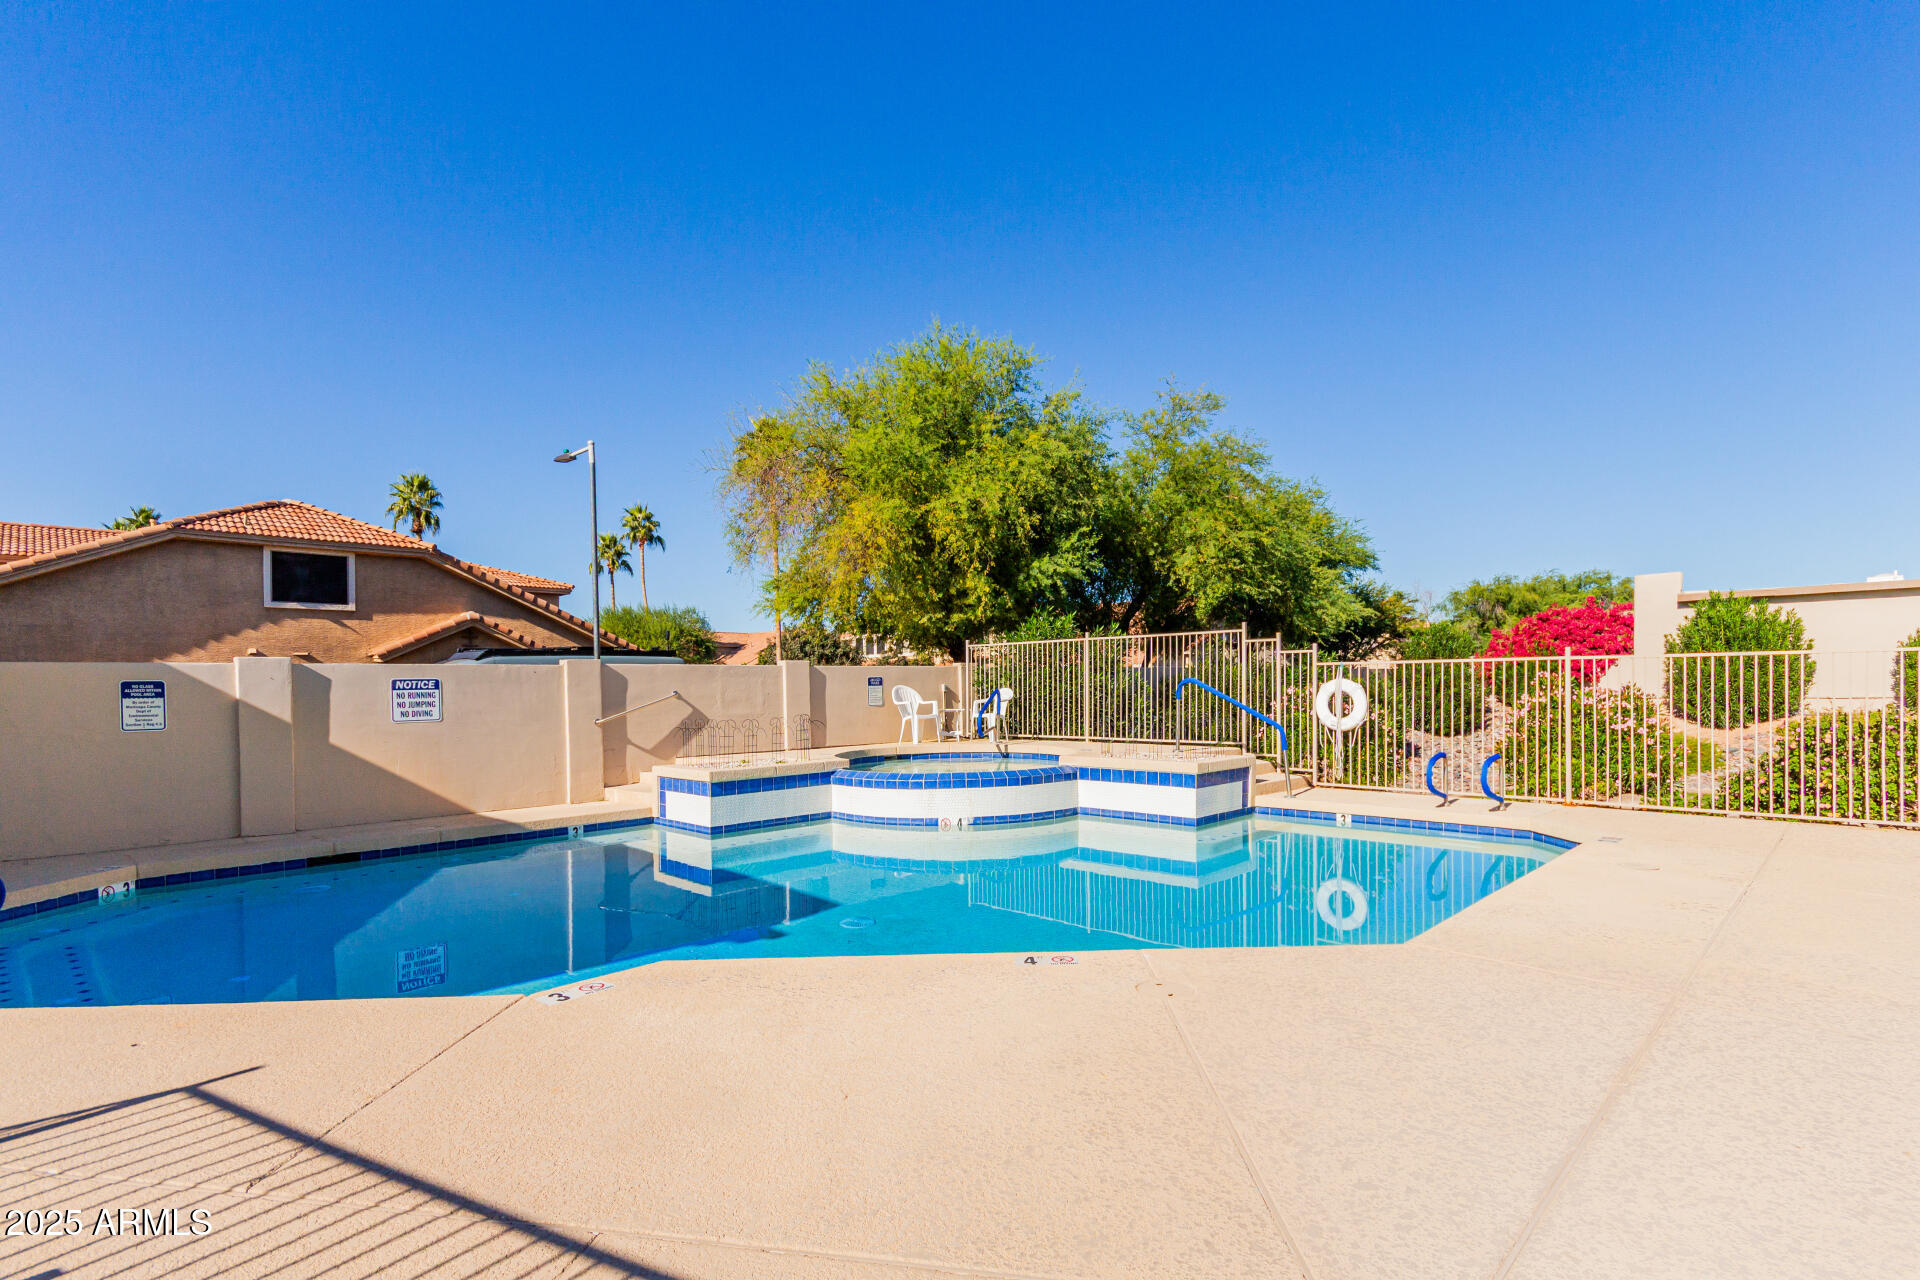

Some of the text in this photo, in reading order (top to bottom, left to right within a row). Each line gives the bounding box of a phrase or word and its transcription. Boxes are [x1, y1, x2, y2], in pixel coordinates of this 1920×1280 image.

[395, 680, 436, 689] NOTICE
[407, 691, 436, 699] RUNNING
[408, 700, 436, 708] JUMPING
[400, 710, 409, 718] NO
[1340, 814, 1346, 826] 3
[1023, 956, 1037, 965] 4
[548, 992, 571, 1002] 3
